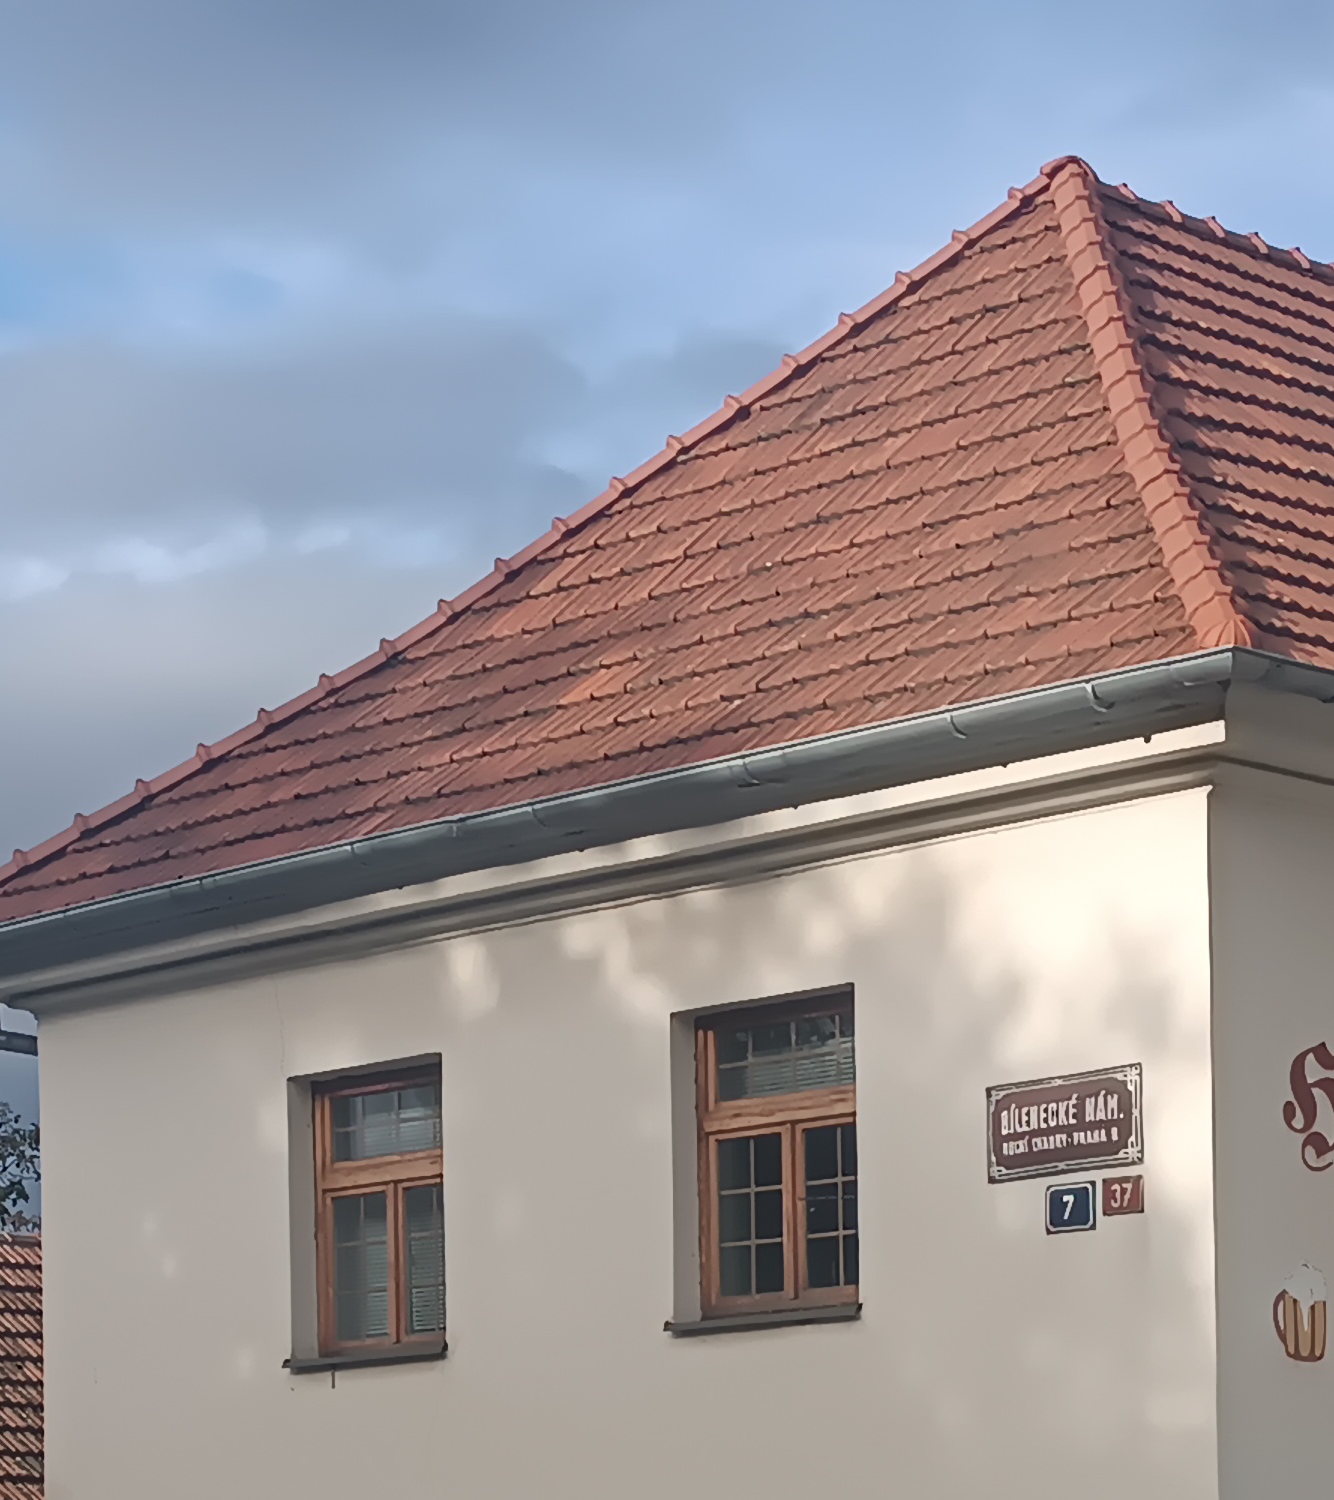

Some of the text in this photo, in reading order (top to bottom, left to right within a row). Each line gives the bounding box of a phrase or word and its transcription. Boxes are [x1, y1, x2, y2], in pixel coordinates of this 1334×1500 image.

[1085, 1089, 1124, 1122] NÁM.
[1062, 1194, 1074, 1220] 7
[1110, 1183, 1132, 1208] 37
